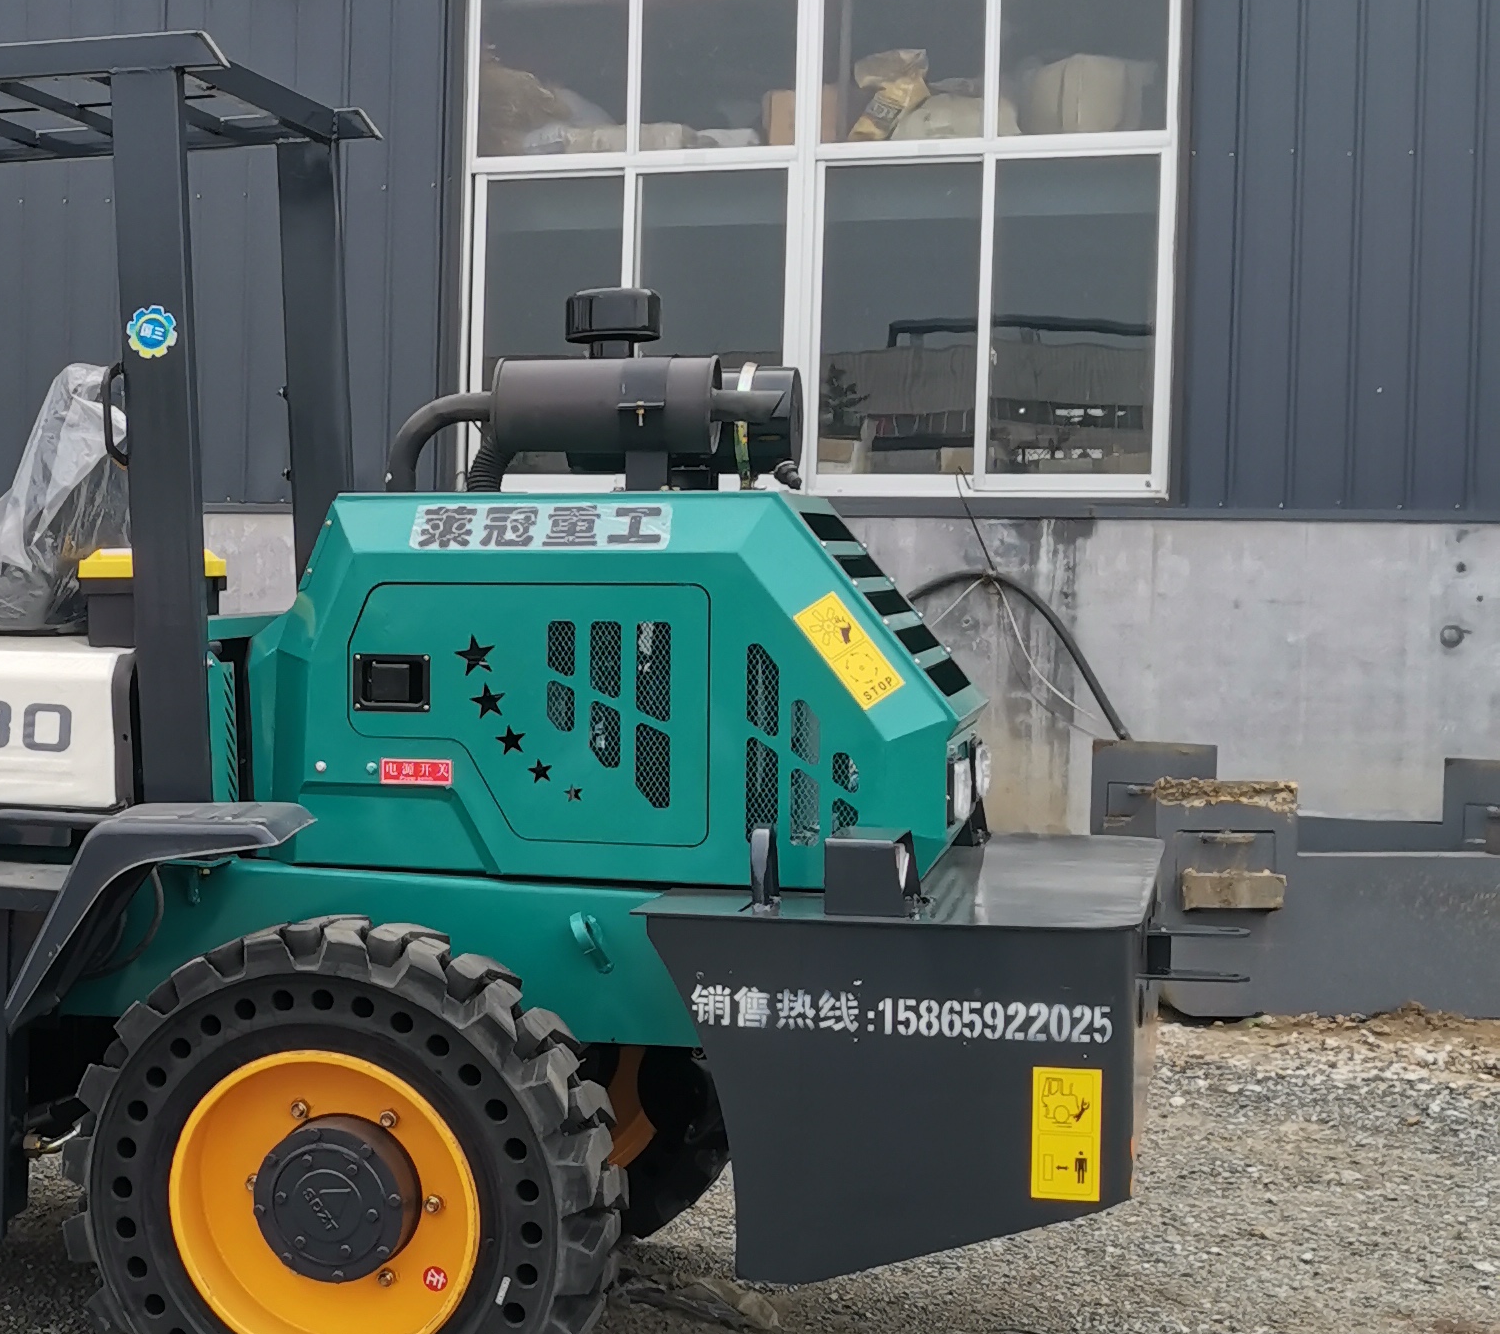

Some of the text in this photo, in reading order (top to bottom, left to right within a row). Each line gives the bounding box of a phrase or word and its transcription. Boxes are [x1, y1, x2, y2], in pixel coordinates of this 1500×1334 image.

[417, 505, 663, 549] 莱冠重工
[863, 676, 892, 701] STOP
[385, 762, 449, 778] 电源开关
[425, 1268, 447, 1290] 左
